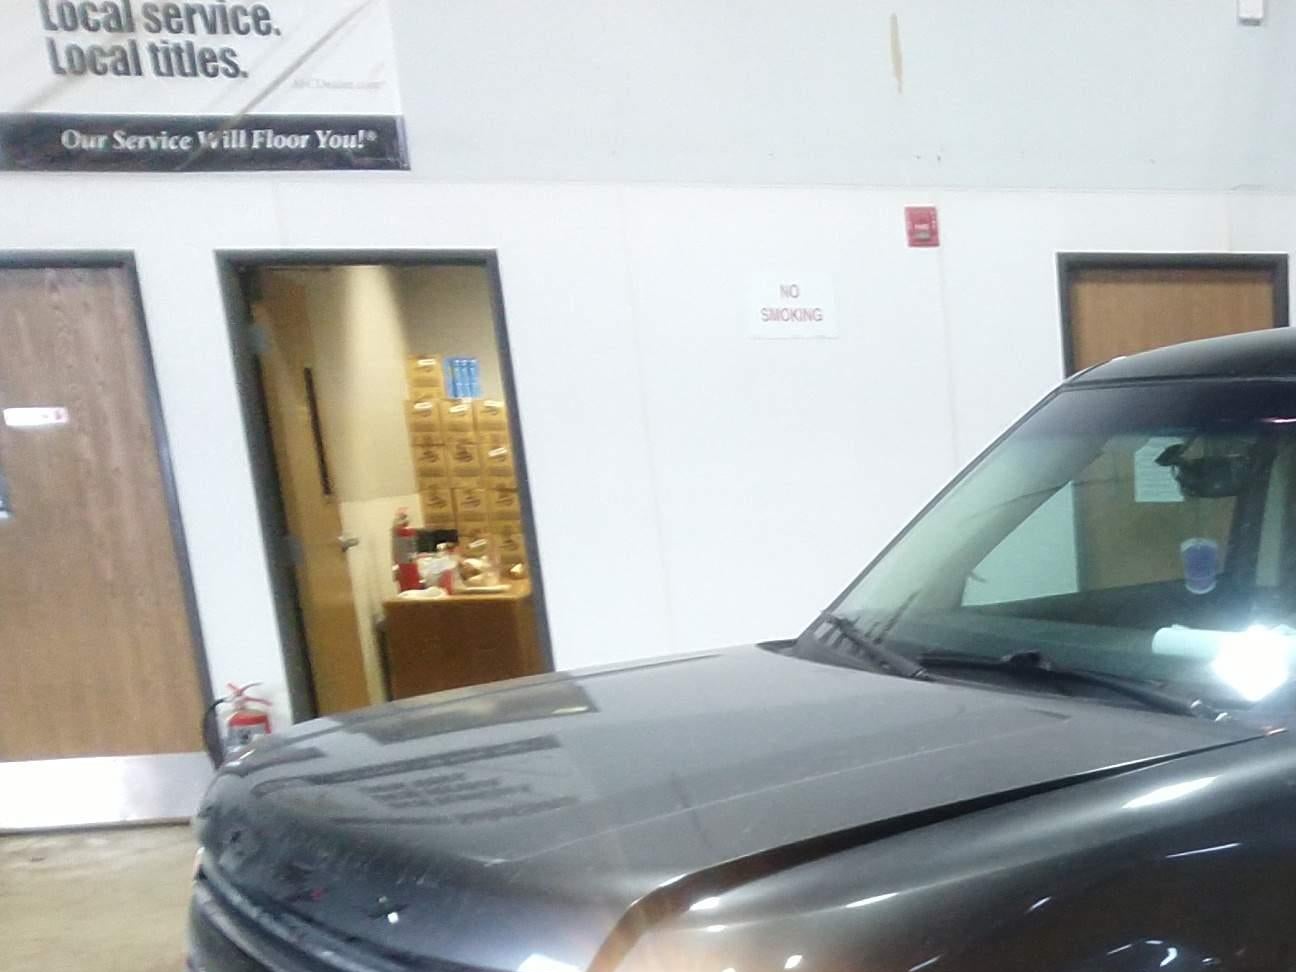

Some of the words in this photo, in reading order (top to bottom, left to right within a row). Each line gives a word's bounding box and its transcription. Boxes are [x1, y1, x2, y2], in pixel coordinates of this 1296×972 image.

[36, 0, 136, 33] Local
[141, 0, 281, 36] service.
[45, 36, 143, 76] Local
[148, 40, 248, 78] titles.
[61, 128, 106, 150] Our
[112, 129, 193, 150] Service
[197, 129, 246, 149] Will
[251, 129, 312, 150] Floor
[779, 284, 800, 298] NO
[760, 307, 823, 322] SMOKING
